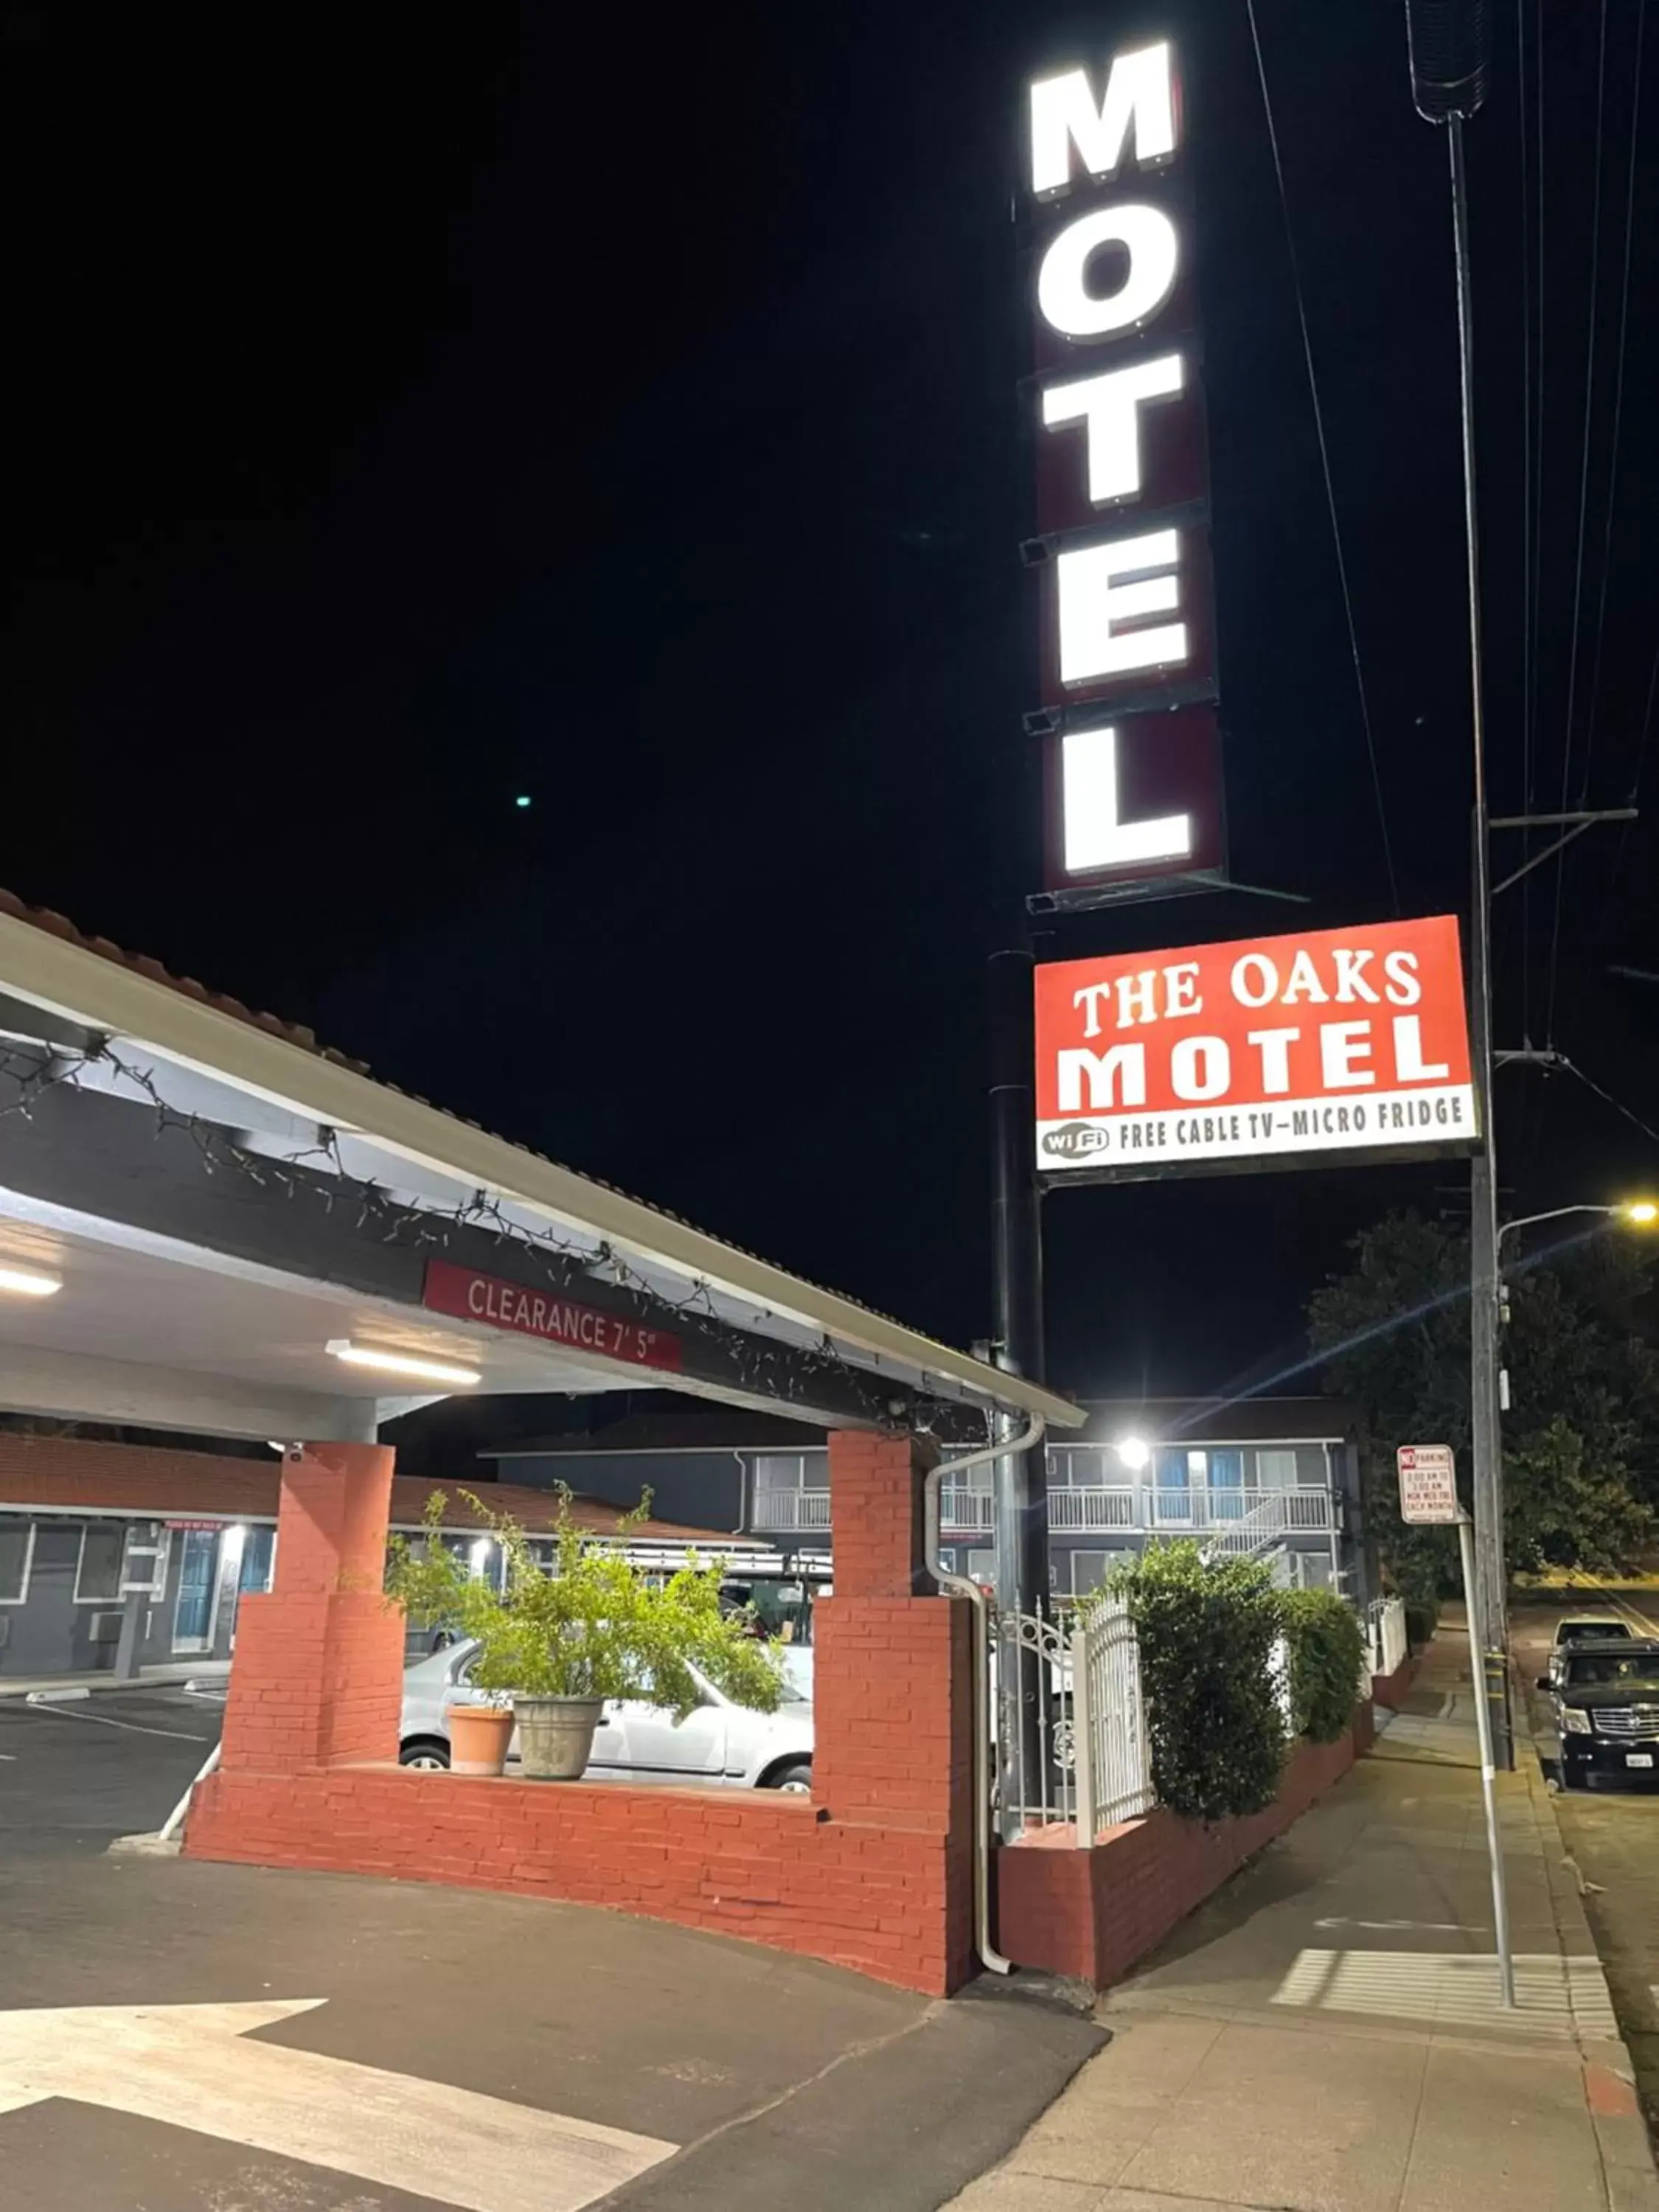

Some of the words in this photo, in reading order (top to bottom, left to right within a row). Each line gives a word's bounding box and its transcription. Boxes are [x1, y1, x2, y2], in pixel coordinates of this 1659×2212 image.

[1030, 41, 1191, 875] MOTEL
[1073, 961, 1204, 1038] THE
[1231, 949, 1422, 1008] OAKS
[1057, 1014, 1450, 1112] MOTEL
[1120, 1121, 1166, 1149] FREE
[1177, 1115, 1239, 1145] CABLE
[1377, 1096, 1462, 1130] FRIDGE
[467, 1279, 605, 1349] CLEARANCE
[613, 1322, 630, 1352] 7'
